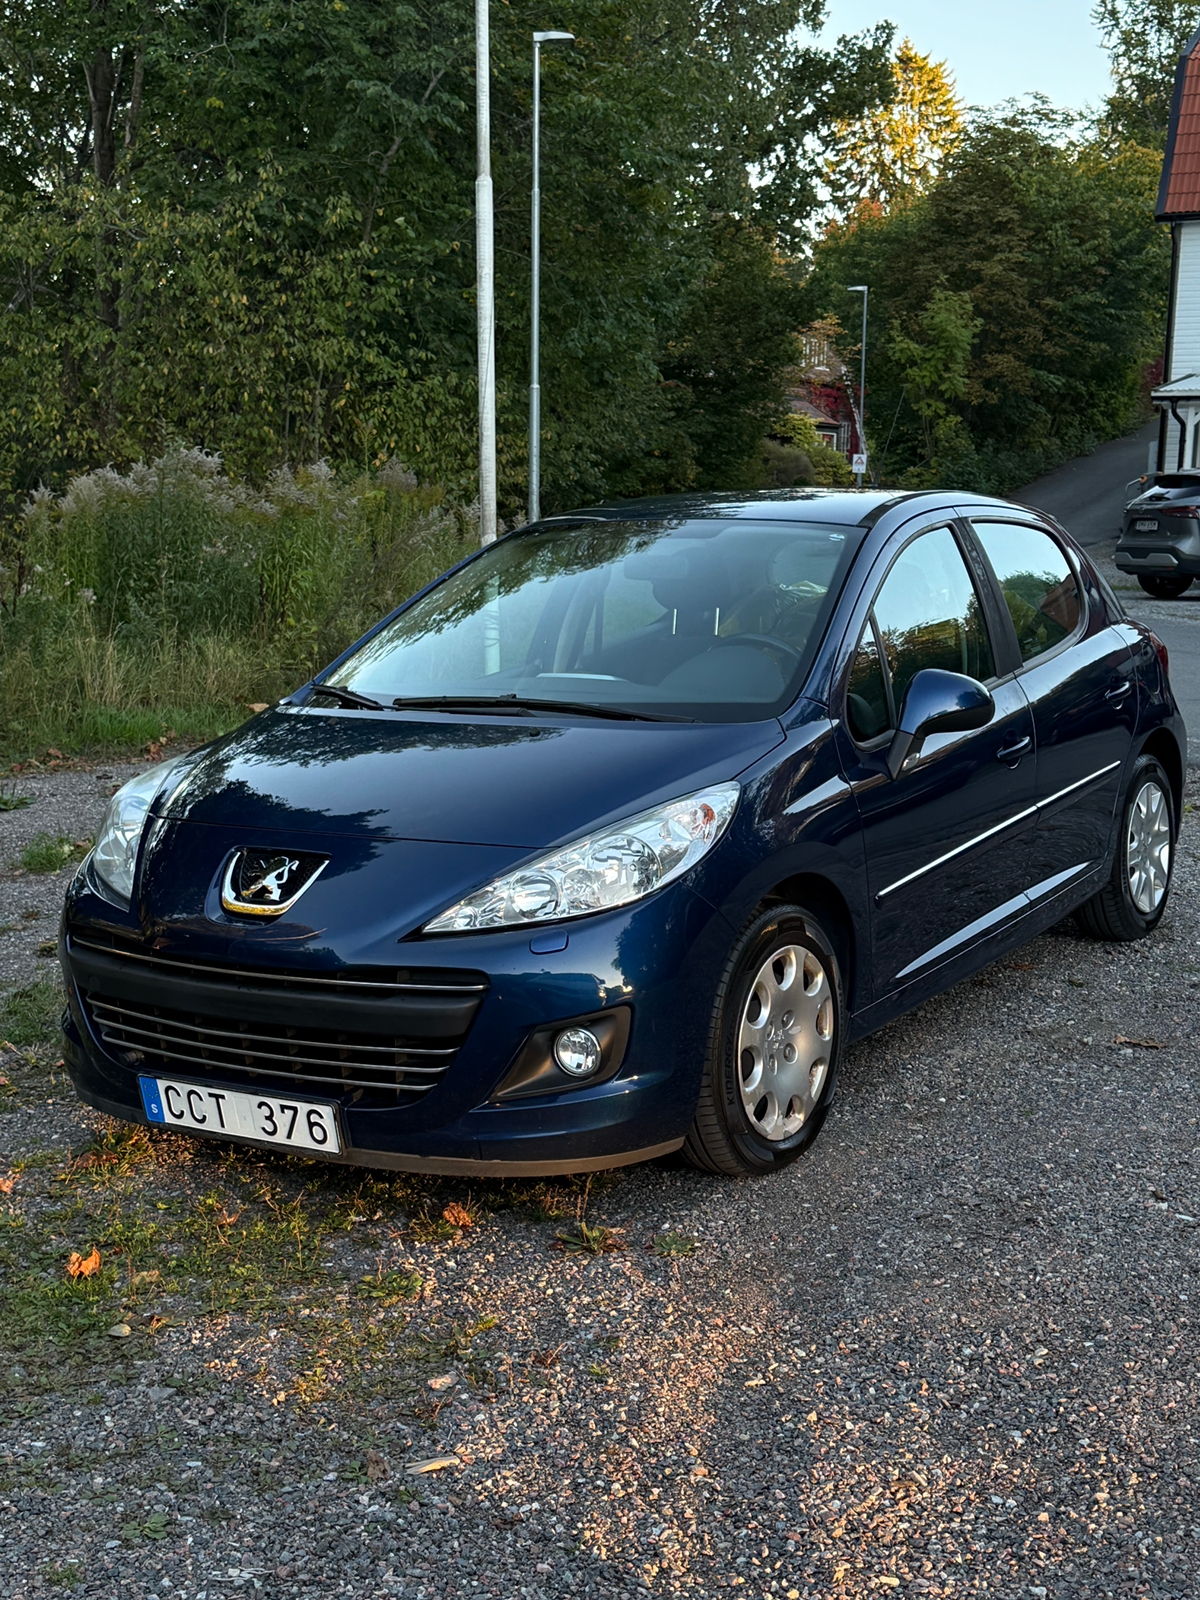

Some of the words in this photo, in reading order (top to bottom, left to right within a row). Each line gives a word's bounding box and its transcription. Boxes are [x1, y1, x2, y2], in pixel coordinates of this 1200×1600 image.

[724, 1035, 735, 1105] KINERGY
[150, 1103, 159, 1114] S
[164, 1085, 226, 1129] CCT
[256, 1101, 328, 1145] 376
